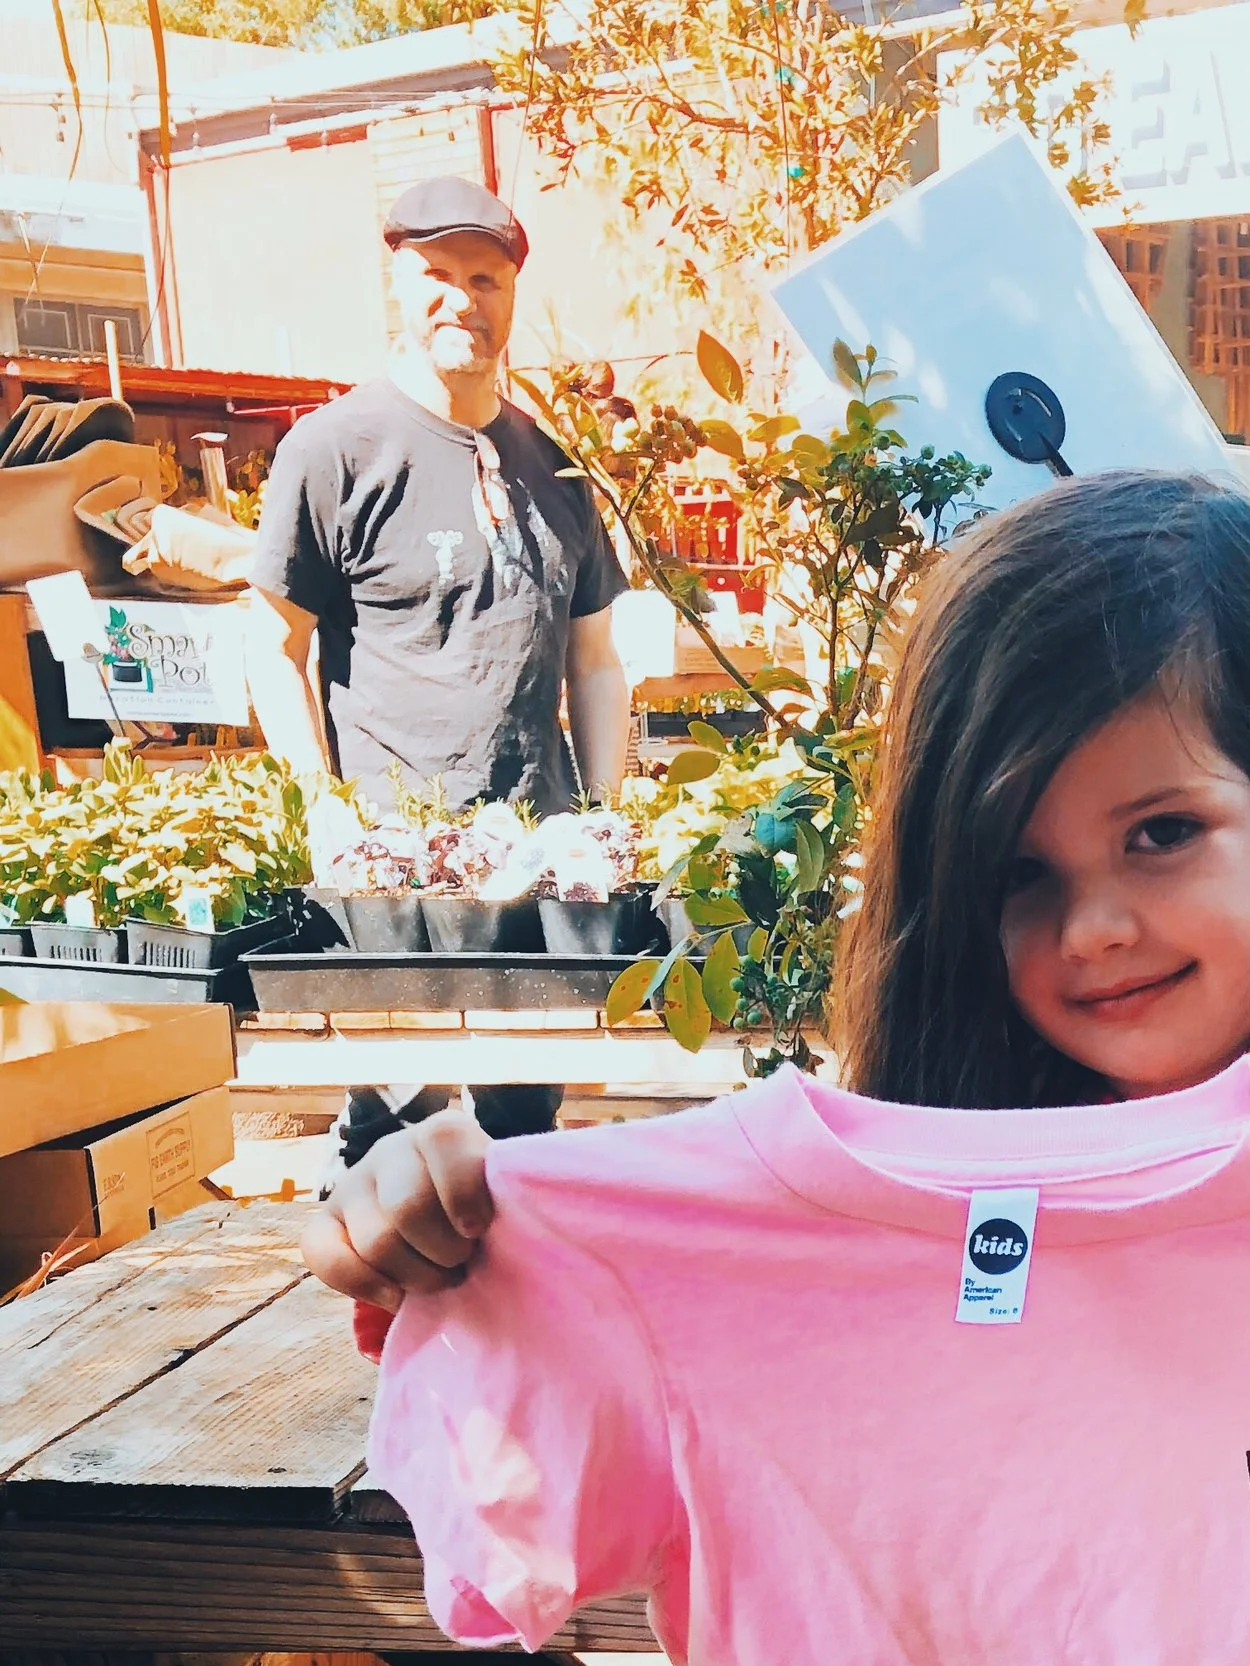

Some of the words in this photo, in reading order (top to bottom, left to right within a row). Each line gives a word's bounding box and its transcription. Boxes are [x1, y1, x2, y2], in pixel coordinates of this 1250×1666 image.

[150, 654, 213, 688] Pot
[973, 1234, 1024, 1257] kids
[964, 1286, 1003, 1294] American
[965, 1277, 976, 1287] By
